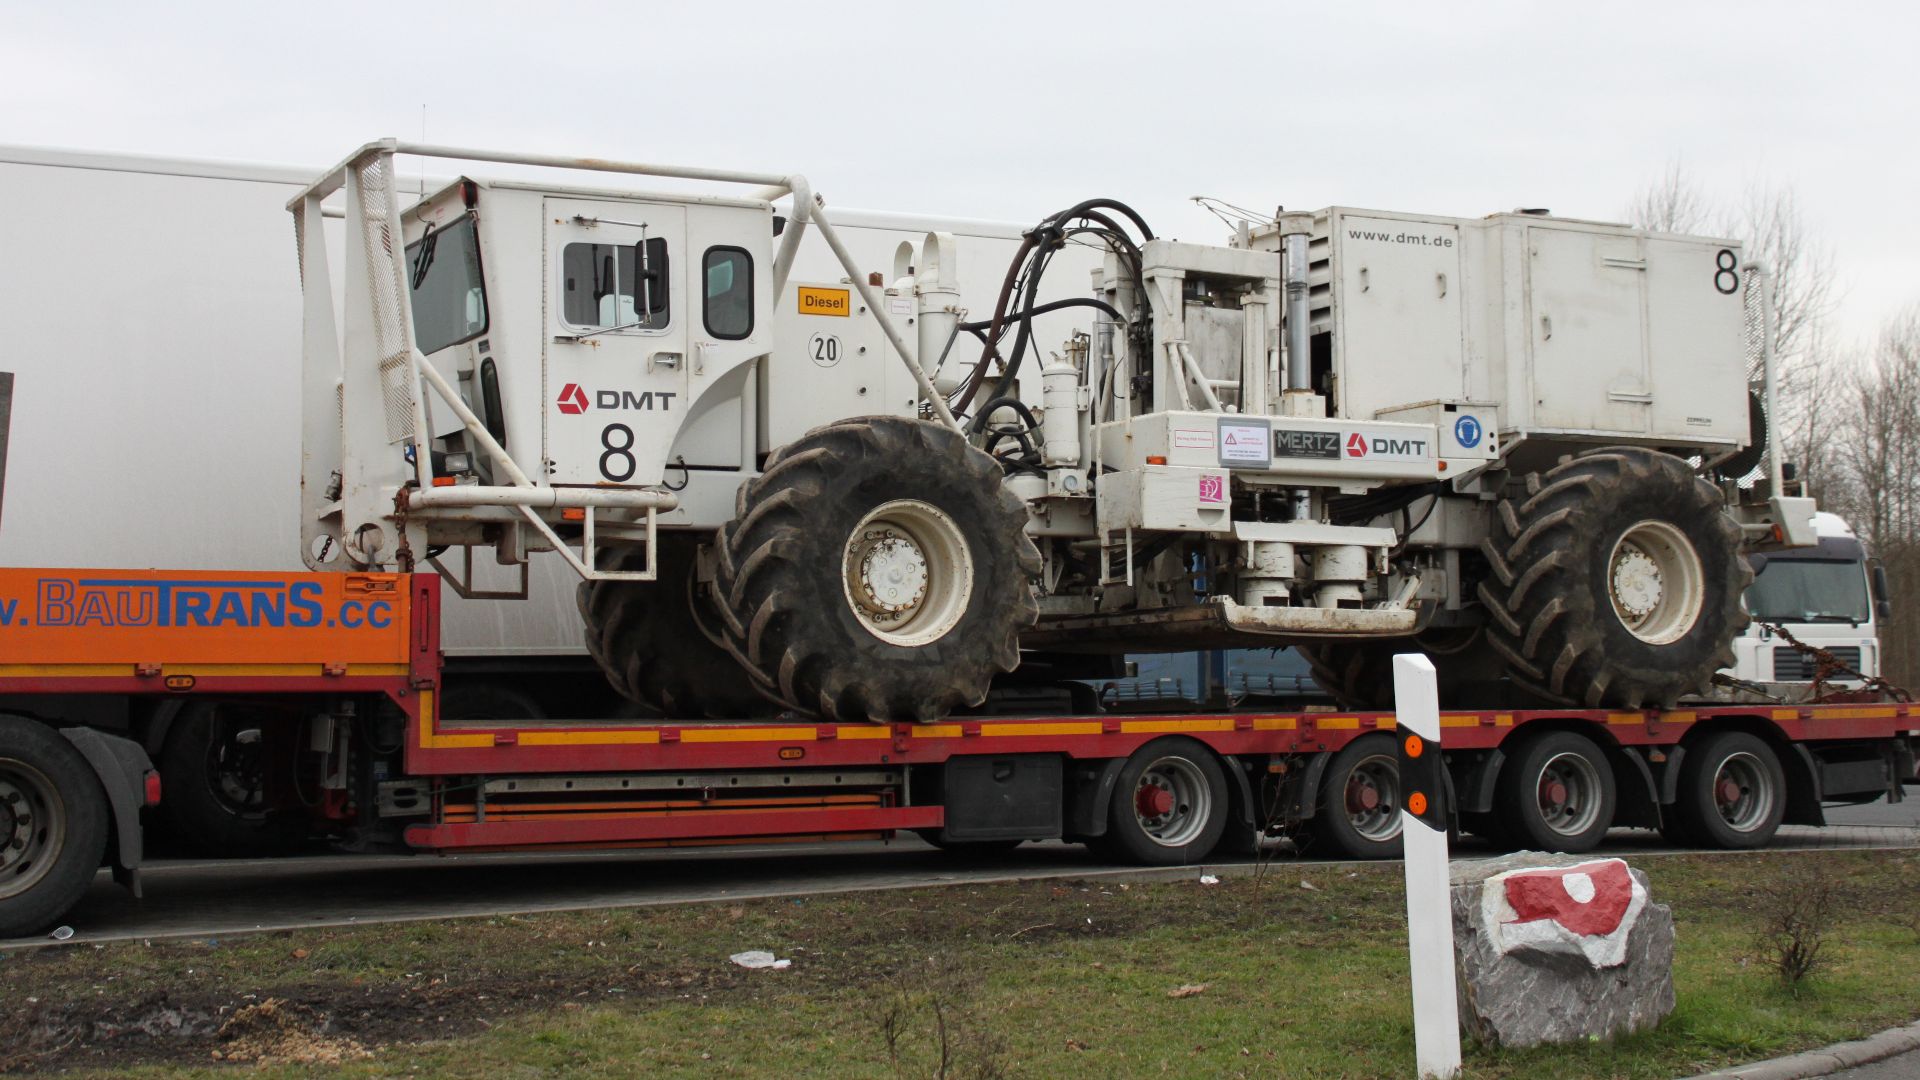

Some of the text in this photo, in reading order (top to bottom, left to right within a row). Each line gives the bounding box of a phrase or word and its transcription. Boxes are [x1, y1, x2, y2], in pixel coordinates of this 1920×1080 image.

[1349, 230, 1453, 248] www.dmt.de
[1714, 249, 1739, 295] 8
[805, 295, 844, 309] Diesel
[815, 337, 837, 361] 20
[596, 390, 677, 411] DMT
[1277, 432, 1337, 450] MERTZ
[1372, 438, 1426, 456] DMT
[599, 423, 637, 482] 8
